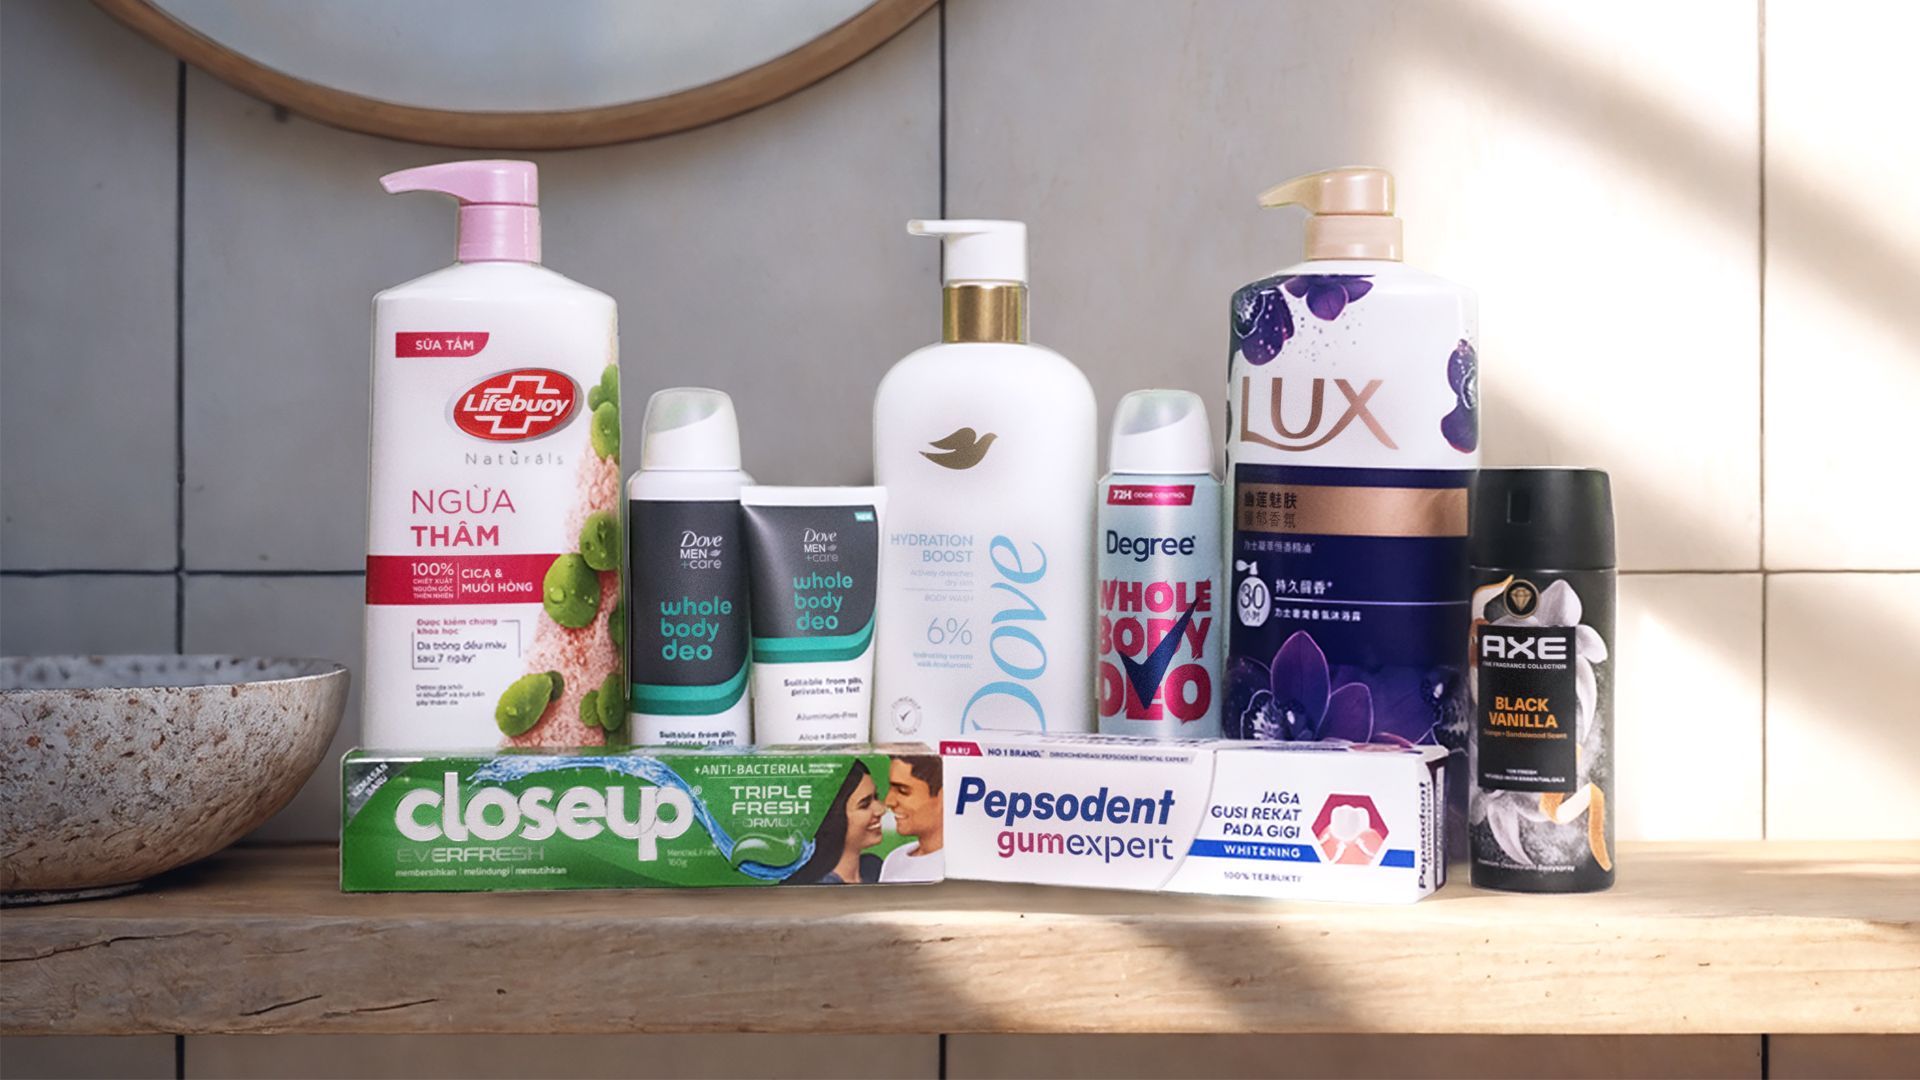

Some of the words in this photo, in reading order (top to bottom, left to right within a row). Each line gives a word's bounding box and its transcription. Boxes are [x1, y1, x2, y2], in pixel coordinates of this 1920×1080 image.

[416, 337, 442, 352] SỮA
[446, 335, 474, 351] TẮM
[464, 393, 571, 417] Lifebuoy
[1240, 376, 1400, 452] LUX
[411, 485, 516, 514] NGỪA
[1113, 489, 1132, 500] 72H
[410, 521, 499, 547] THÂM
[680, 530, 724, 548] Dove
[804, 528, 837, 542] Dove
[890, 533, 973, 547] HYDRATION
[680, 549, 707, 559] MEN
[804, 544, 825, 553] MEN
[922, 550, 973, 563] BOOST
[680, 559, 722, 570] +care
[806, 553, 839, 563] +care
[411, 563, 454, 577] 100%
[461, 569, 491, 579] CICA
[494, 569, 502, 579] &
[461, 581, 494, 593] MUỐI
[498, 581, 533, 593] HỒNG
[793, 571, 853, 589] whole
[794, 592, 843, 613] body
[1099, 580, 1212, 613] WHOLE
[1240, 582, 1266, 609] 30
[660, 596, 732, 616] whole
[796, 612, 838, 630] deo
[660, 618, 720, 642] body
[927, 617, 973, 645] 6%
[960, 534, 1047, 737] Dove
[1099, 616, 1212, 660] BODY
[417, 641, 431, 650] Da
[661, 639, 713, 660] deo
[1482, 635, 1567, 660] AXE
[417, 655, 435, 663] sau
[437, 654, 443, 663] 7
[1493, 661, 1526, 670] FRAGRANCE
[826, 678, 846, 686] from
[1495, 696, 1549, 712] BLACK
[1488, 712, 1559, 729] VANILLA
[945, 745, 971, 755] BARU
[987, 748, 1001, 756] NO
[694, 763, 807, 775] +ANTI-BACTERIAL
[729, 785, 812, 800] TRIPLE
[1261, 791, 1300, 804] JAGA
[731, 801, 809, 815] FRESH
[955, 776, 1175, 827] Pepsodent
[395, 772, 695, 861] closeup
[1211, 805, 1247, 819] GUSI
[1251, 807, 1302, 821] REKAT
[1223, 823, 1263, 837] PADA
[1267, 825, 1300, 839] GIGI
[1418, 782, 1426, 889] Pepsodent
[396, 847, 545, 862] EVERFRESH
[997, 831, 1174, 863] gumexpert
[1223, 845, 1301, 859] WHITENING
[395, 868, 457, 877] membersihkan
[464, 866, 510, 877] melindungi
[515, 866, 567, 876] memutihkan
[1224, 871, 1250, 880] 100%
